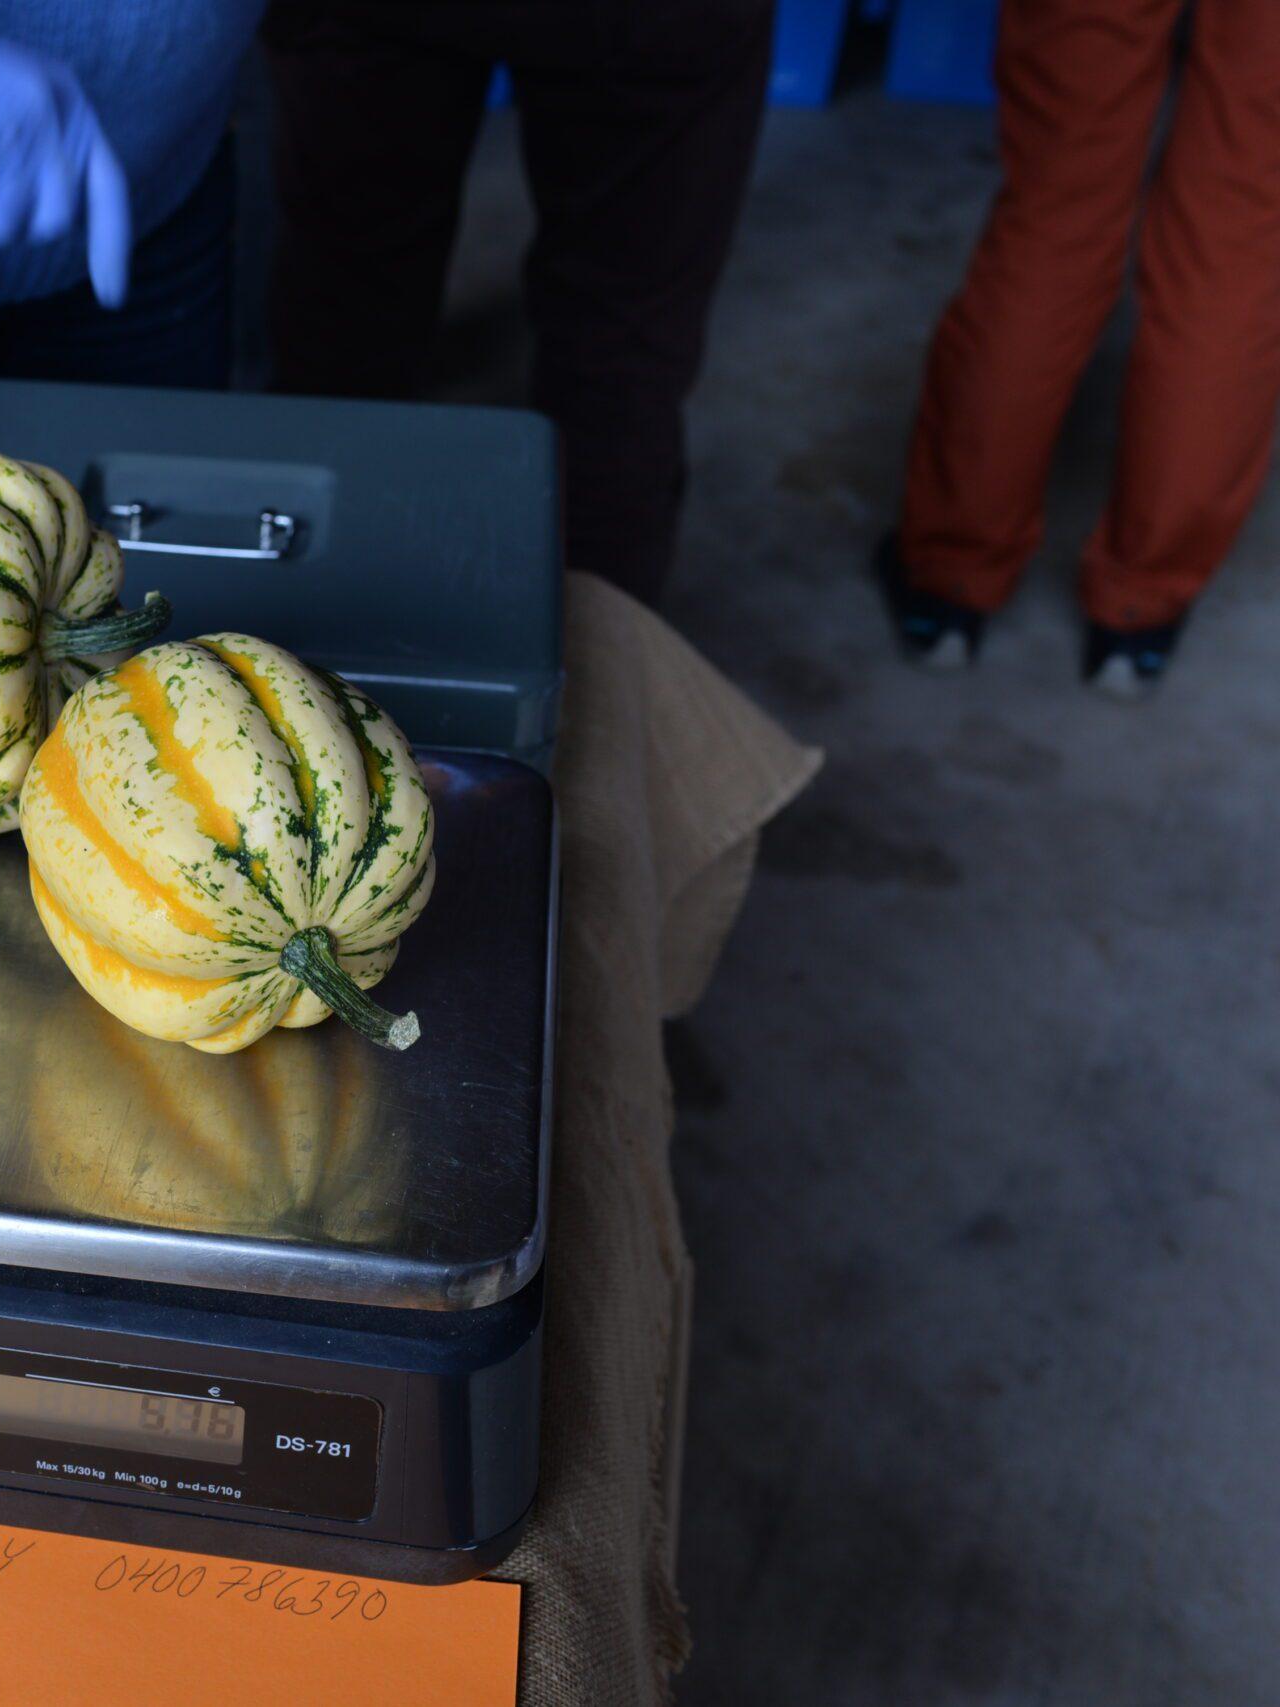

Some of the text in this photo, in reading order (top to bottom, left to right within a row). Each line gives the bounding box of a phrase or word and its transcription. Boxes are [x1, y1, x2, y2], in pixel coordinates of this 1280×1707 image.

[276, 1434, 351, 1458] DS-781
[36, 1460, 59, 1472] Max
[62, 1464, 91, 1477] 15/30
[92, 1468, 106, 1480] kg
[115, 1471, 136, 1483] Min
[139, 1474, 159, 1486] 100
[95, 1555, 207, 1598] 0400
